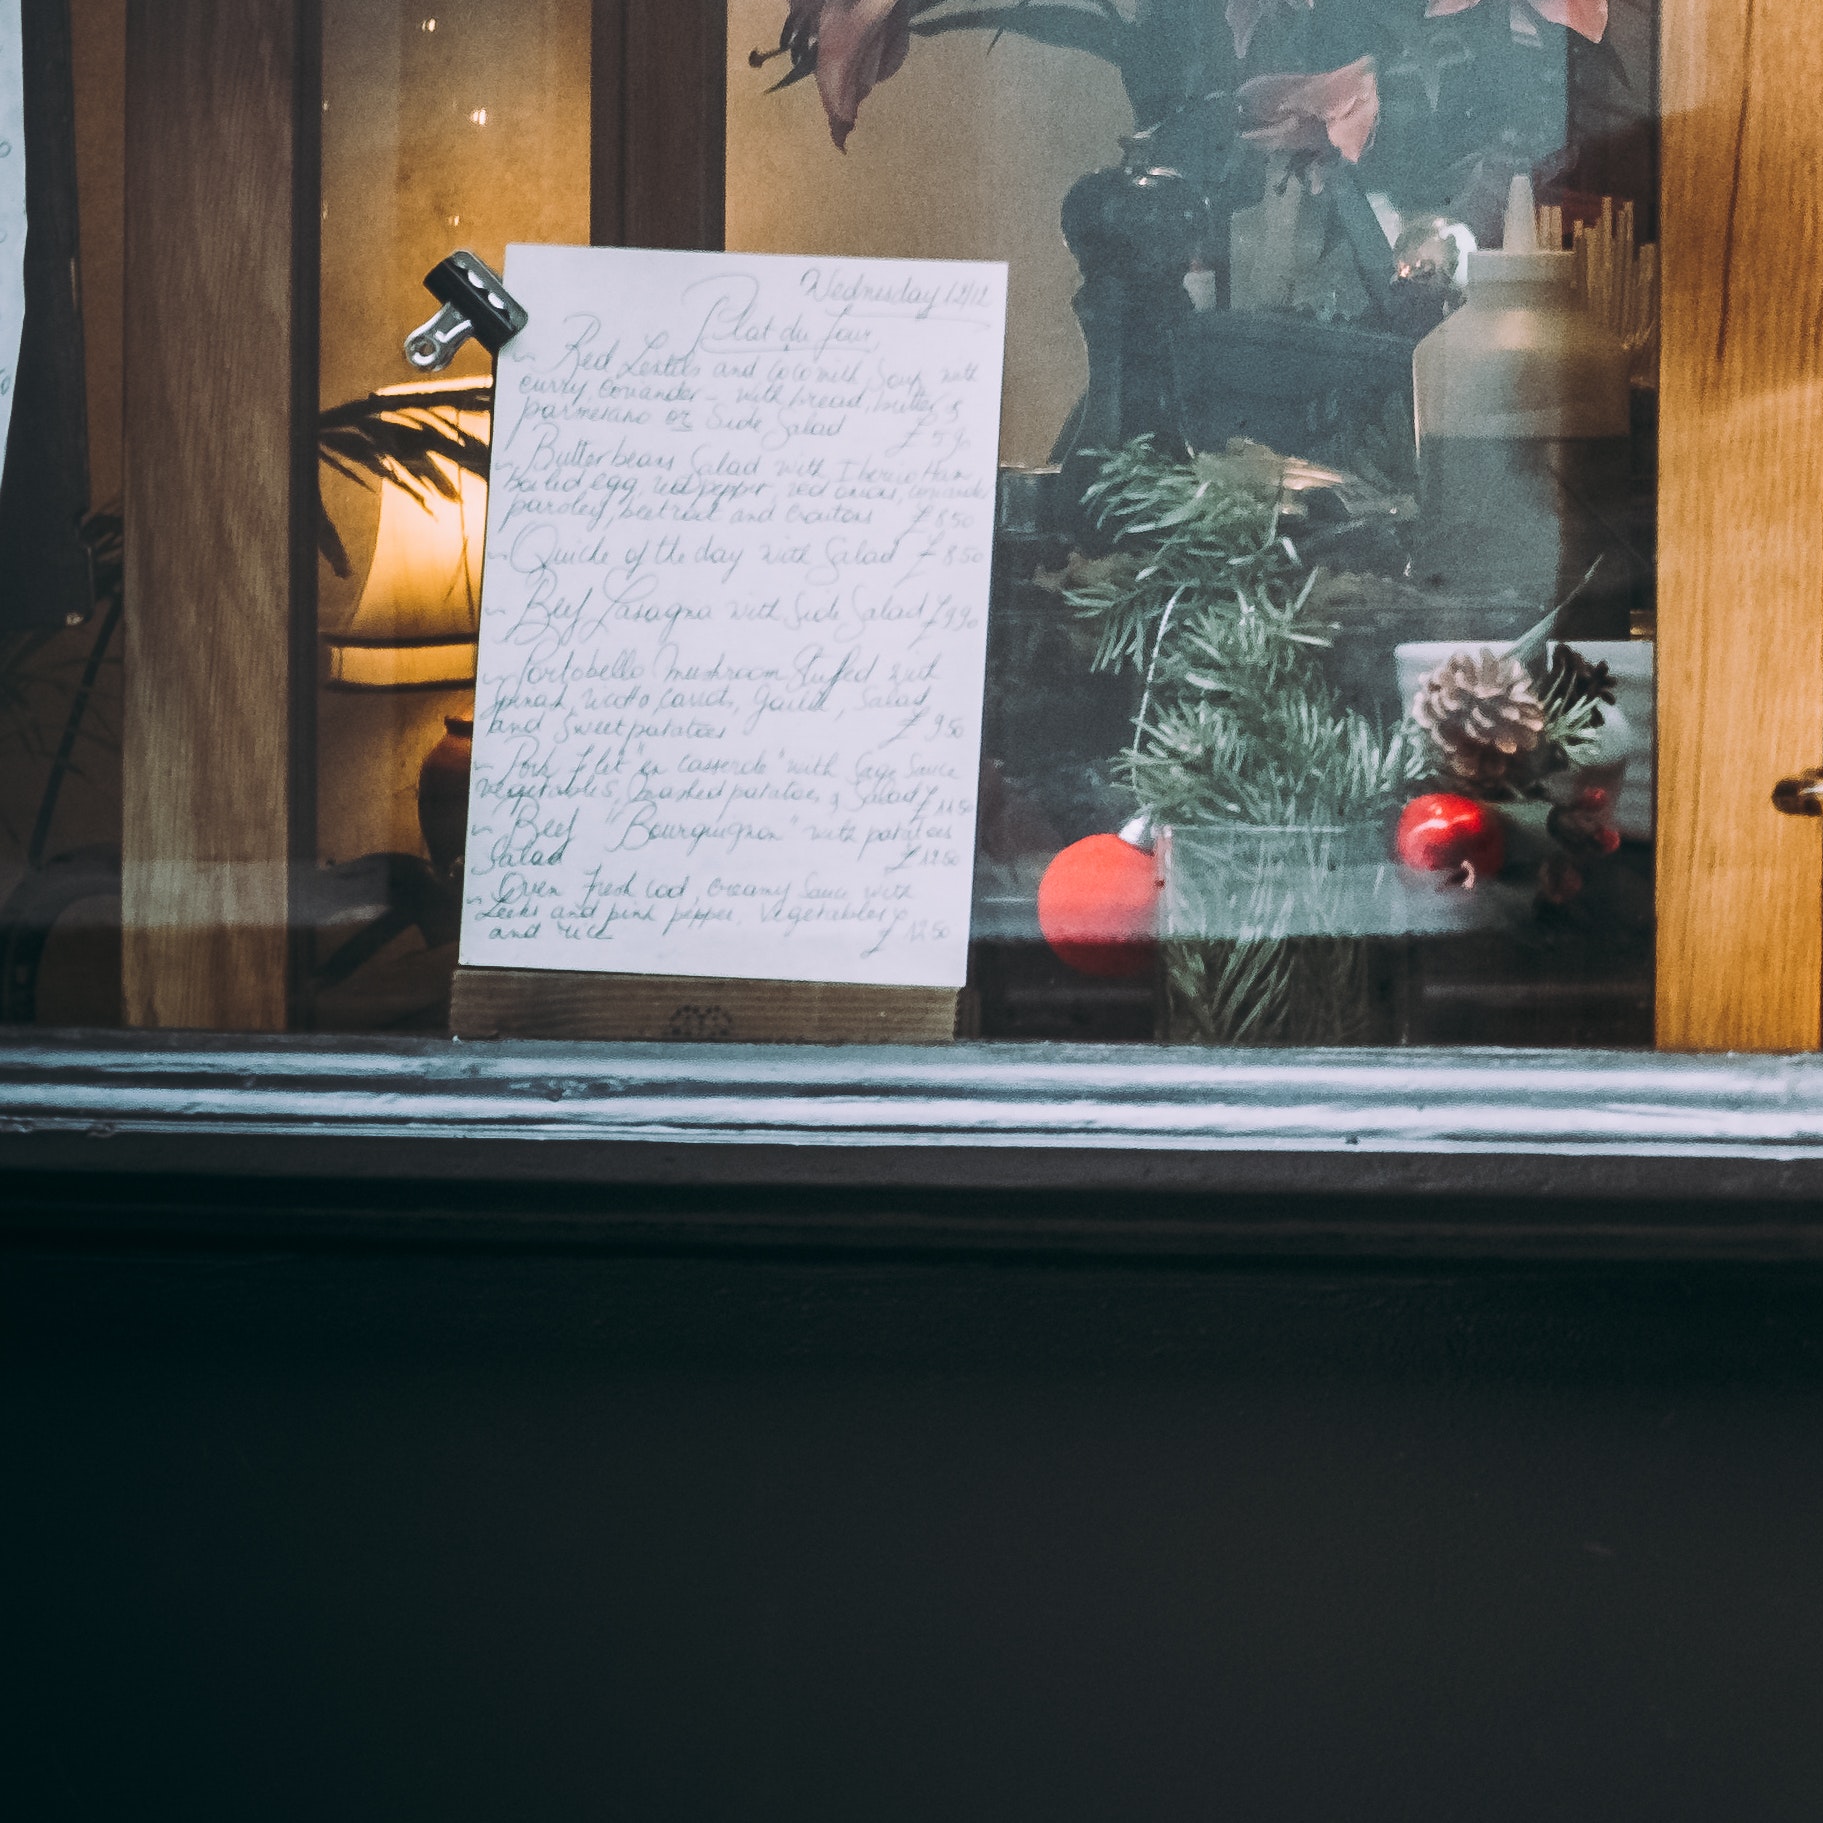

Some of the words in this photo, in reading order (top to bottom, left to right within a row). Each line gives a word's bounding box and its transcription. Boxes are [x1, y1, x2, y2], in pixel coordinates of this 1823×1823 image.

[713, 356, 761, 378] and
[728, 503, 777, 523] and
[694, 533, 744, 584] day
